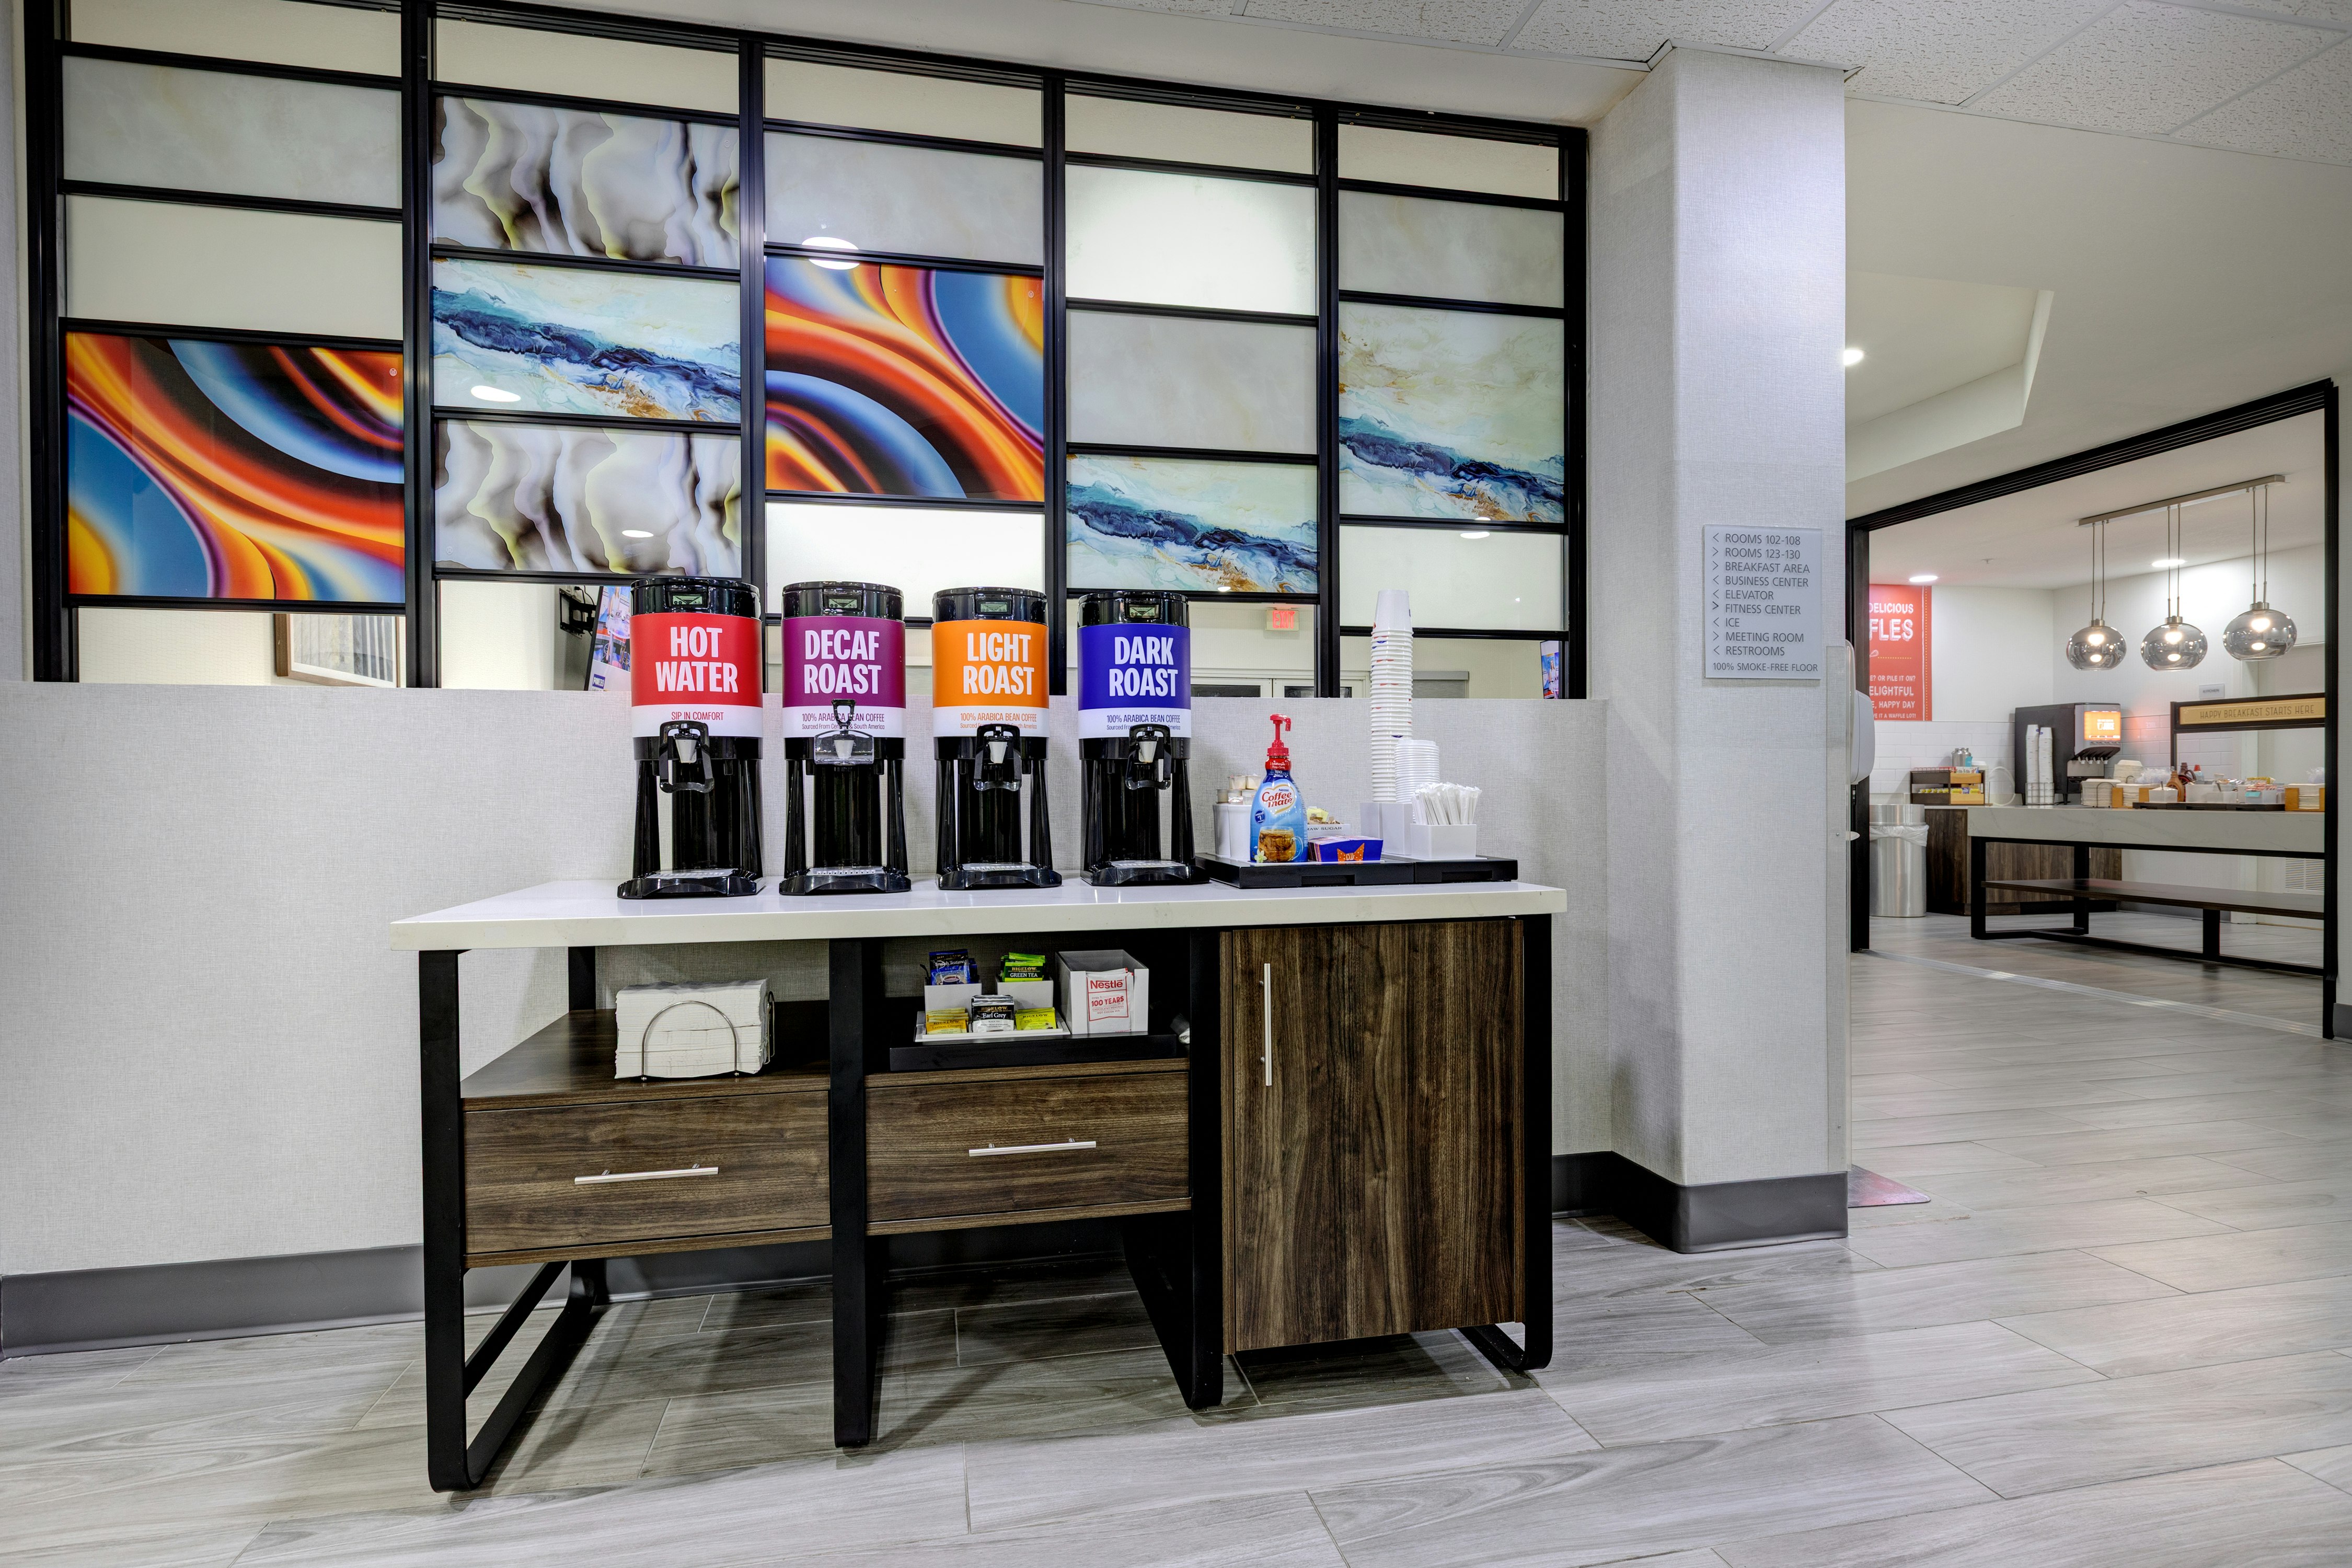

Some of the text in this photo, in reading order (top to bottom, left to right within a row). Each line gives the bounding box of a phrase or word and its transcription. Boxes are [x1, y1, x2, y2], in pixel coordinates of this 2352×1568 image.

[1725, 534, 1801, 545] ROOMS 102-108
[1725, 548, 1801, 559] ROOMS 123-130
[1725, 562, 1810, 573] BREAKFAST AREA
[1725, 576, 1808, 587] BUSINESS CENTER
[1725, 590, 1774, 600] ELEVATOR
[1725, 604, 1801, 615] FITNESS CENTER
[1869, 603, 1913, 614] DELICIOUS
[1273, 610, 1295, 629] EXIT
[1726, 618, 1739, 627] ICE
[1869, 619, 1913, 641] FLES
[670, 626, 723, 658] HOT
[1726, 632, 1804, 643] MEETING ROOM
[805, 629, 880, 661] DECAF
[967, 632, 1032, 663] LIGHT
[1114, 636, 1174, 665] DARK
[1726, 646, 1785, 656] RESTROOMS
[1713, 662, 1734, 671] 100%
[1737, 663, 1789, 671] SMOKE-FREE
[655, 661, 739, 693] WATER
[804, 663, 882, 695] ROAST
[963, 665, 1035, 696] ROAST
[1109, 667, 1179, 697] ROAST
[1869, 686, 1914, 696] ELIGHTFUL
[671, 711, 724, 720] SIP IN COMFORT
[802, 713, 817, 722] 100%
[818, 713, 846, 722] ARABCA
[866, 713, 884, 722] COFFEE
[960, 712, 1037, 722] 100% ARABICA BEAN COFFEE
[2200, 705, 2314, 719] HAPPY BREAKFAST STARTS HERE
[1123, 714, 1149, 723] ARABICA
[1166, 714, 1180, 723] COFFEE
[1262, 791, 1292, 802] Coffee
[1267, 798, 1293, 808] mate
[1104, 996, 1124, 1005] YEARS
